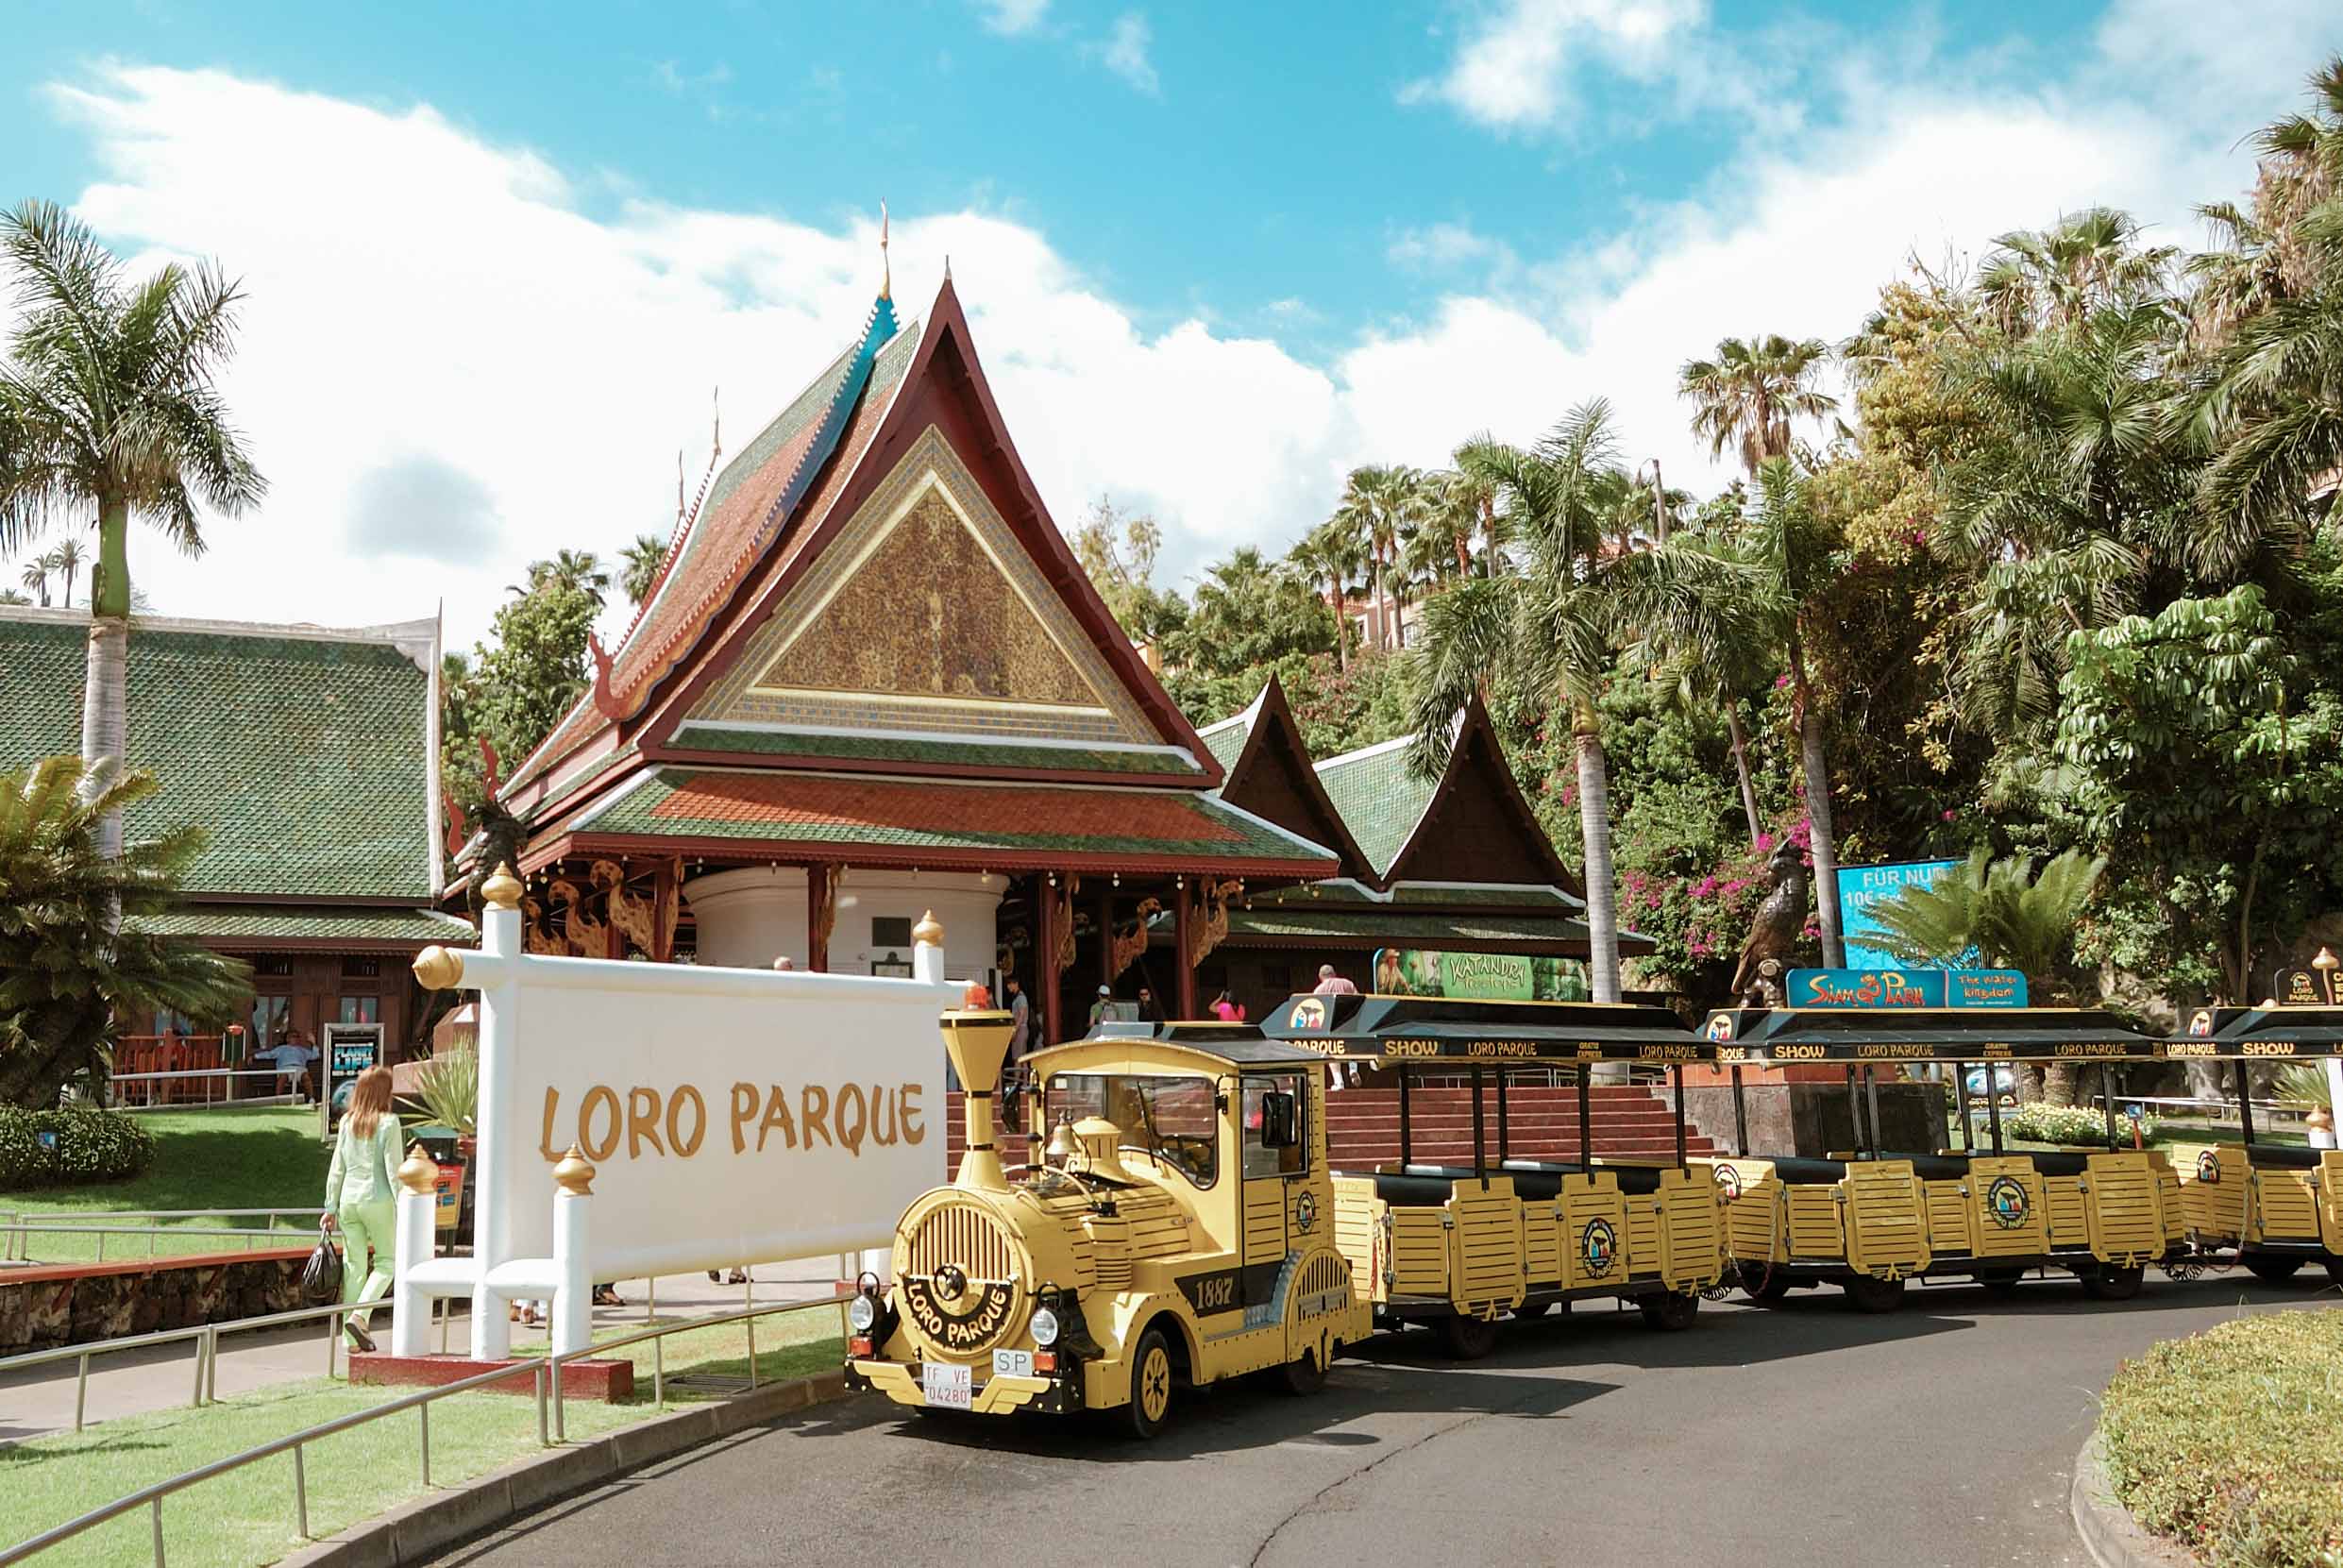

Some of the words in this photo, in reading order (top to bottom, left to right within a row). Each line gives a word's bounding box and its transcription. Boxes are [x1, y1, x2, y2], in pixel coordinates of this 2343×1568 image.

[1863, 868, 1900, 887] FÜR
[1385, 1040, 1439, 1056] SHOW
[1467, 1041, 1496, 1056] LORO
[1497, 1041, 1538, 1057] PARQUE
[1639, 1045, 1662, 1058] LORO
[1663, 1045, 1698, 1059] PARQUE
[1721, 1047, 1745, 1060] RQUE
[1775, 1045, 1826, 1059] SHOW
[1857, 1044, 1888, 1058] LORO
[1890, 1043, 1934, 1057] PARQUE
[2054, 1044, 2082, 1056] LORO
[2084, 1043, 2127, 1056] PARQUE
[2242, 1042, 2295, 1055] SHOW
[540, 1084, 707, 1163] LORO
[731, 1081, 926, 1157] PARQUE
[1195, 1276, 1234, 1309] 1887
[908, 1283, 943, 1335] LORO
[948, 1289, 1007, 1343] PARQUE
[998, 1352, 1027, 1373] SP
[926, 1366, 937, 1381] TF
[953, 1369, 968, 1385] VE
[928, 1386, 968, 1404] 04280
